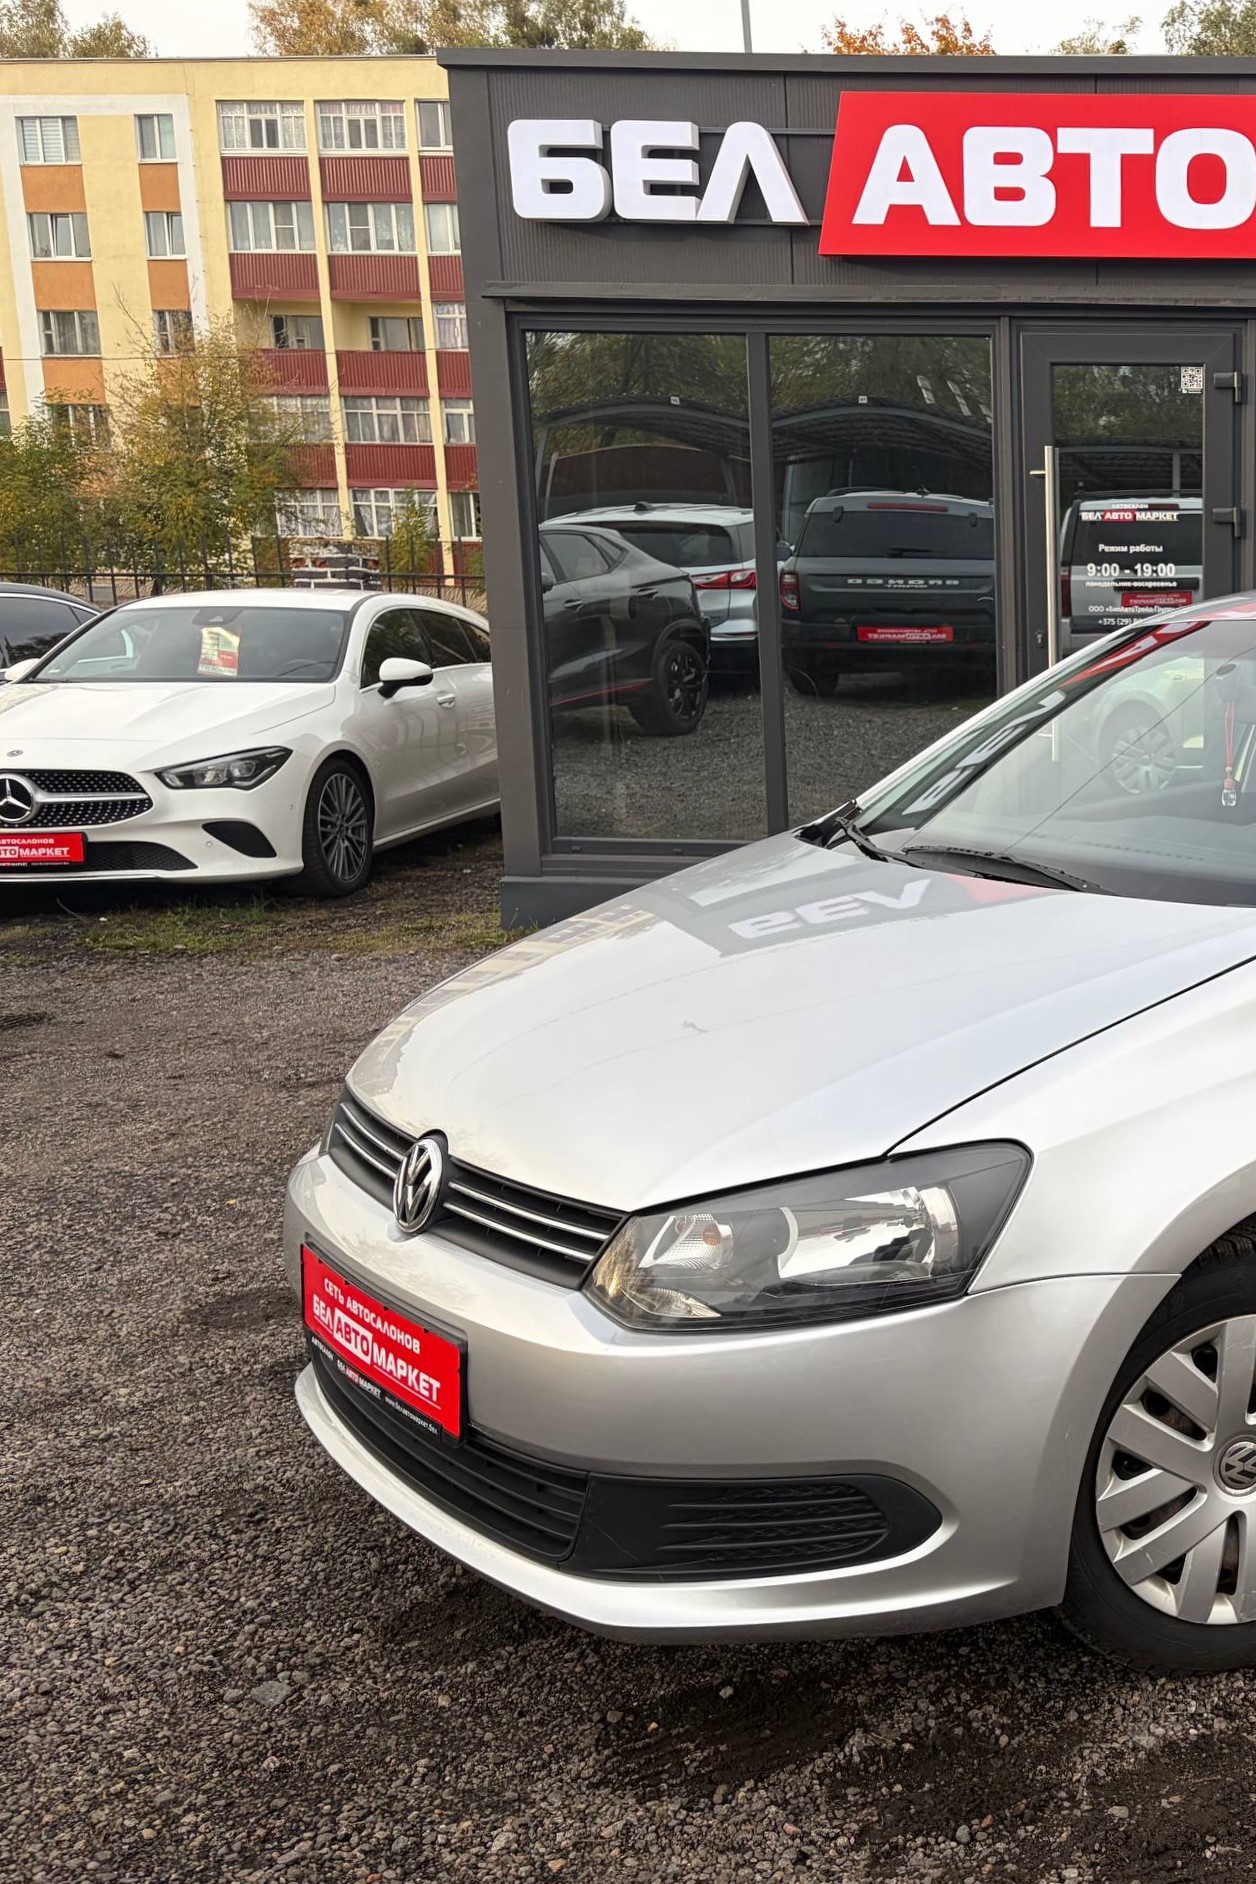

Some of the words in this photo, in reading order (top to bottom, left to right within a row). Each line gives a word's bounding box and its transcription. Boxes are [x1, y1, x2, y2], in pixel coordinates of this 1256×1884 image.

[507, 118, 810, 227] БЕЛ
[1081, 511, 1102, 521] БЕЛ
[1104, 511, 1133, 520] АВТО
[1135, 511, 1180, 521] МАРКЕТ
[1098, 544, 1128, 553] Режим
[1130, 543, 1163, 554] работы
[1086, 562, 1120, 577] 9:00
[1134, 562, 1176, 577] 19:00
[1088, 605, 1105, 613] ООО
[1098, 618, 1116, 626] +375
[1117, 617, 1131, 626] (29)
[19, 847, 70, 857] МАРКЕТ
[323, 1277, 345, 1306] СЕТЬ
[346, 1295, 421, 1355] АВТОСАЛОНОВ
[313, 1292, 334, 1331] БЕЛ
[335, 1314, 371, 1359] АВТО
[372, 1340, 442, 1403] МАРКЕТ
